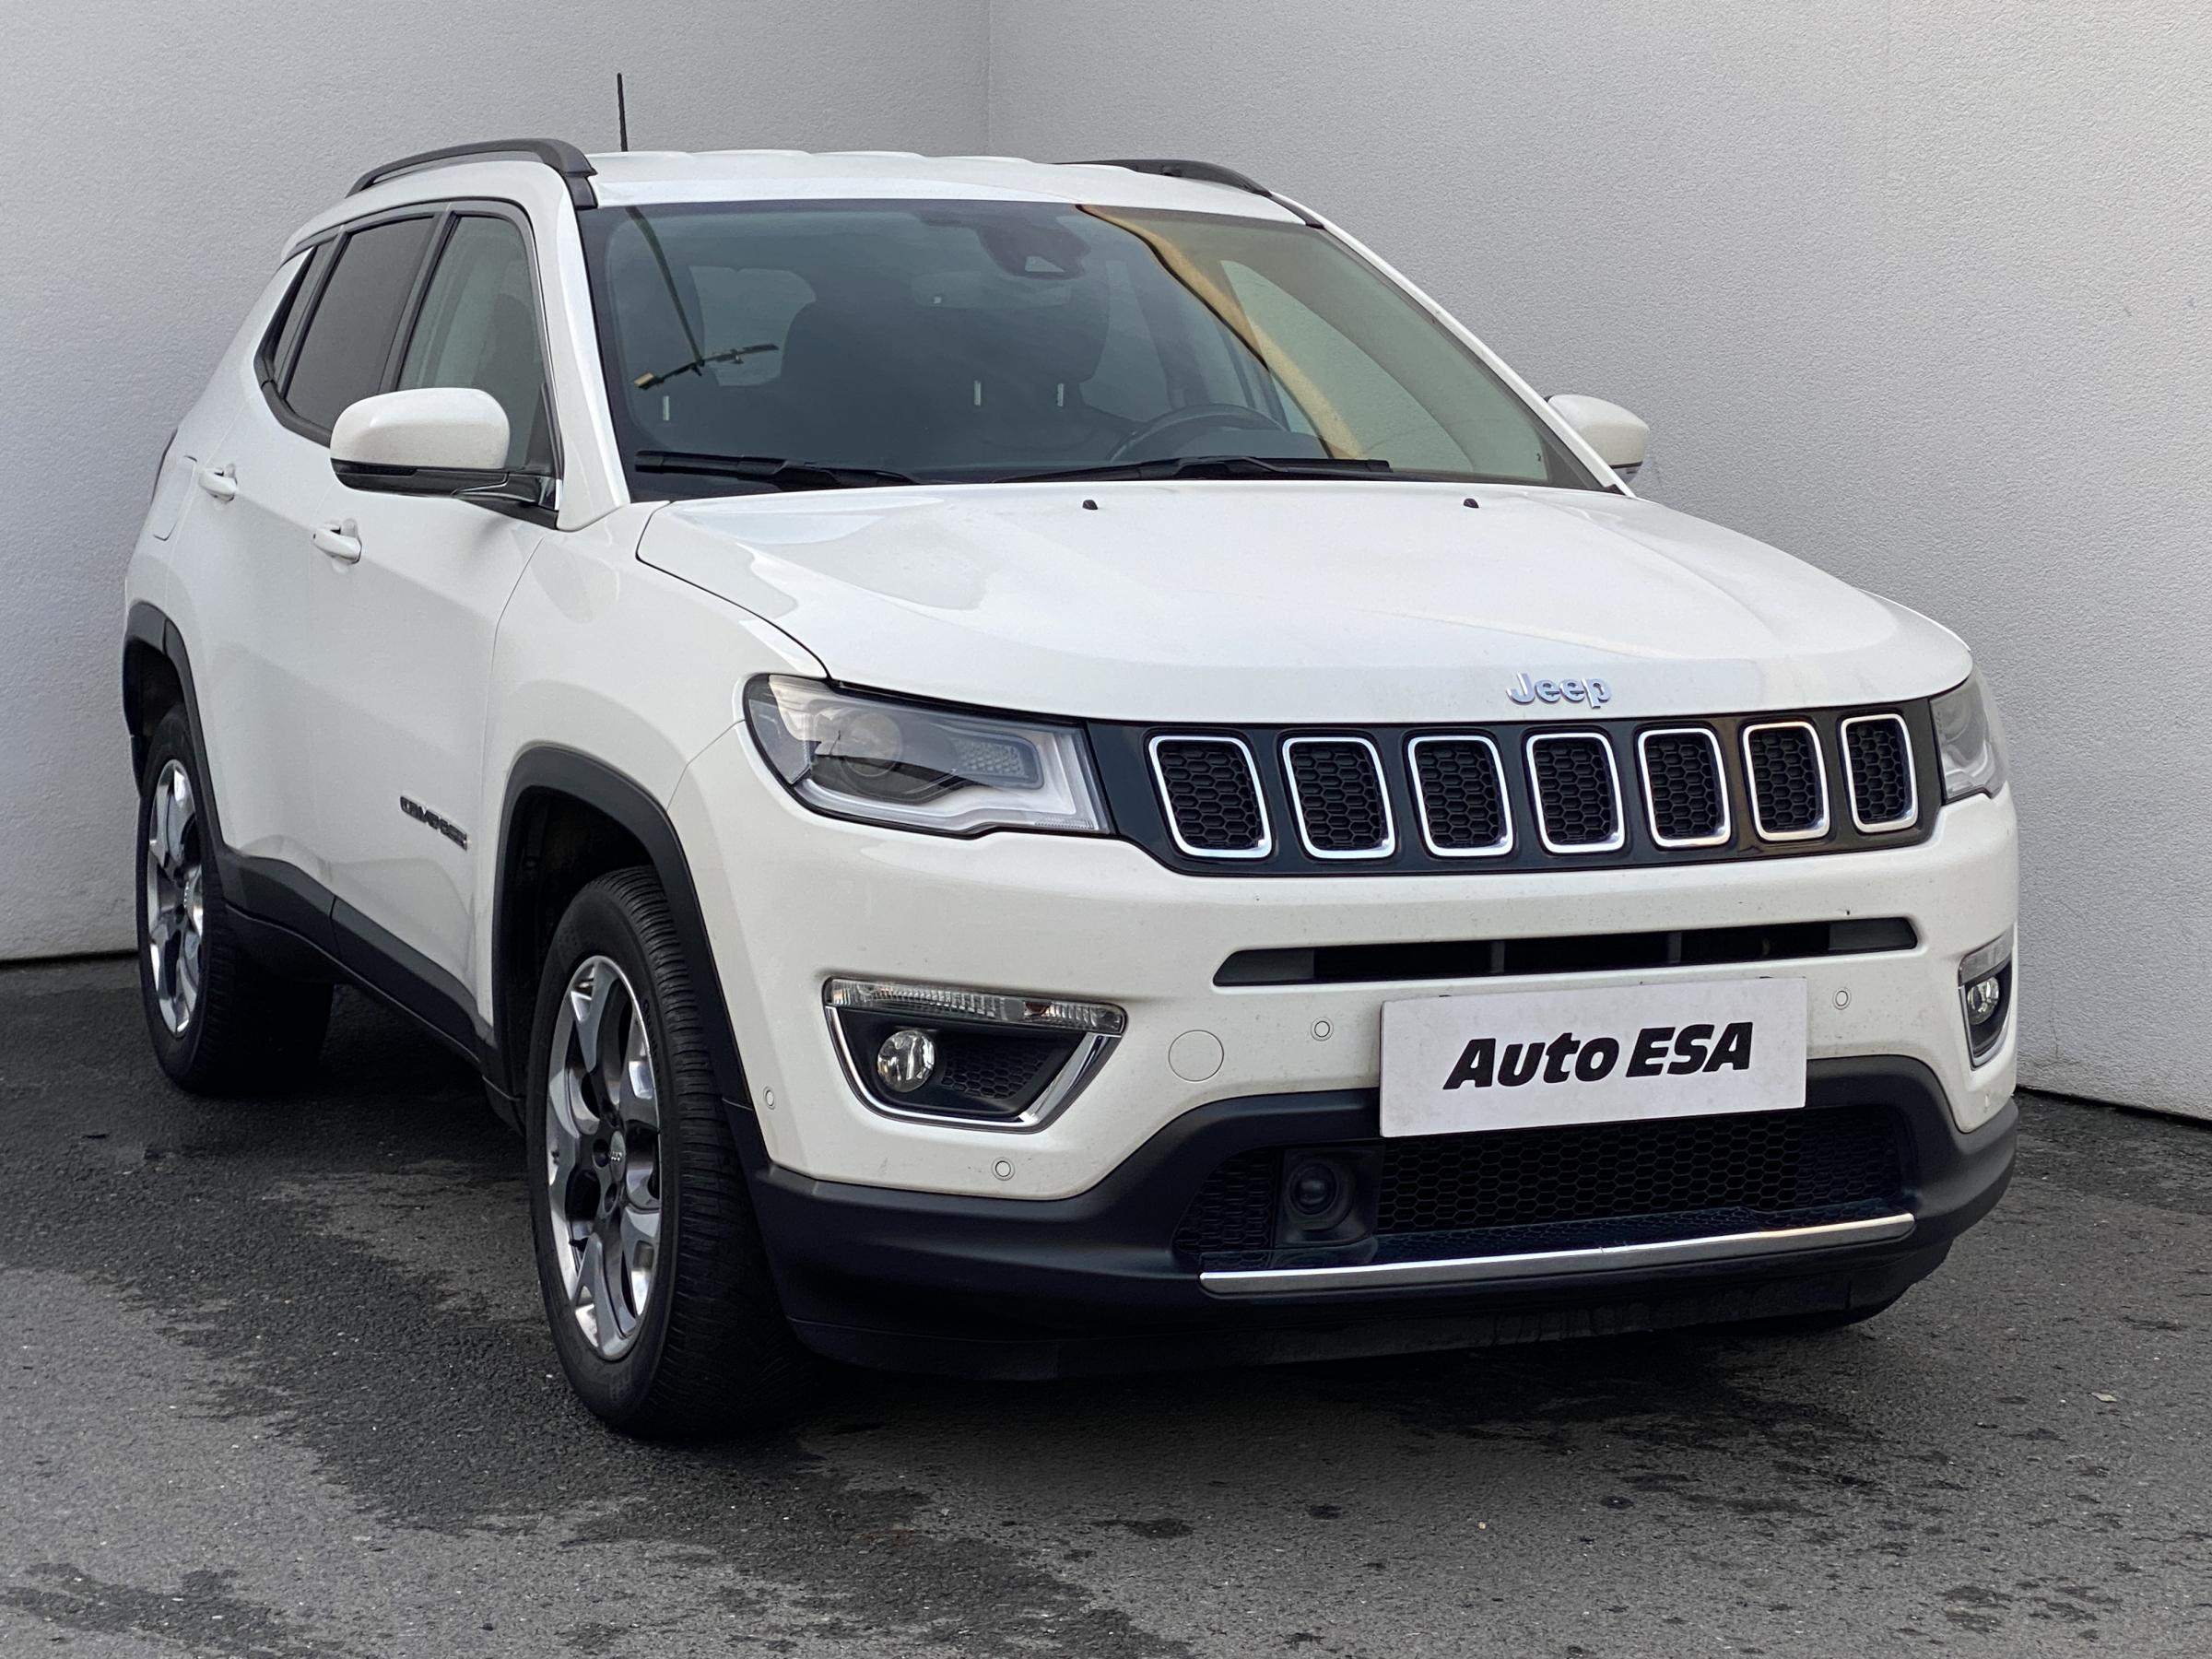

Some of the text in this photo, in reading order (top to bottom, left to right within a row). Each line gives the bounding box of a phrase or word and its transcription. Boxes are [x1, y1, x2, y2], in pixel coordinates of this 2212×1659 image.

[1506, 672, 1611, 709] Jeep
[1442, 1021, 1753, 1090] Auto ESA
